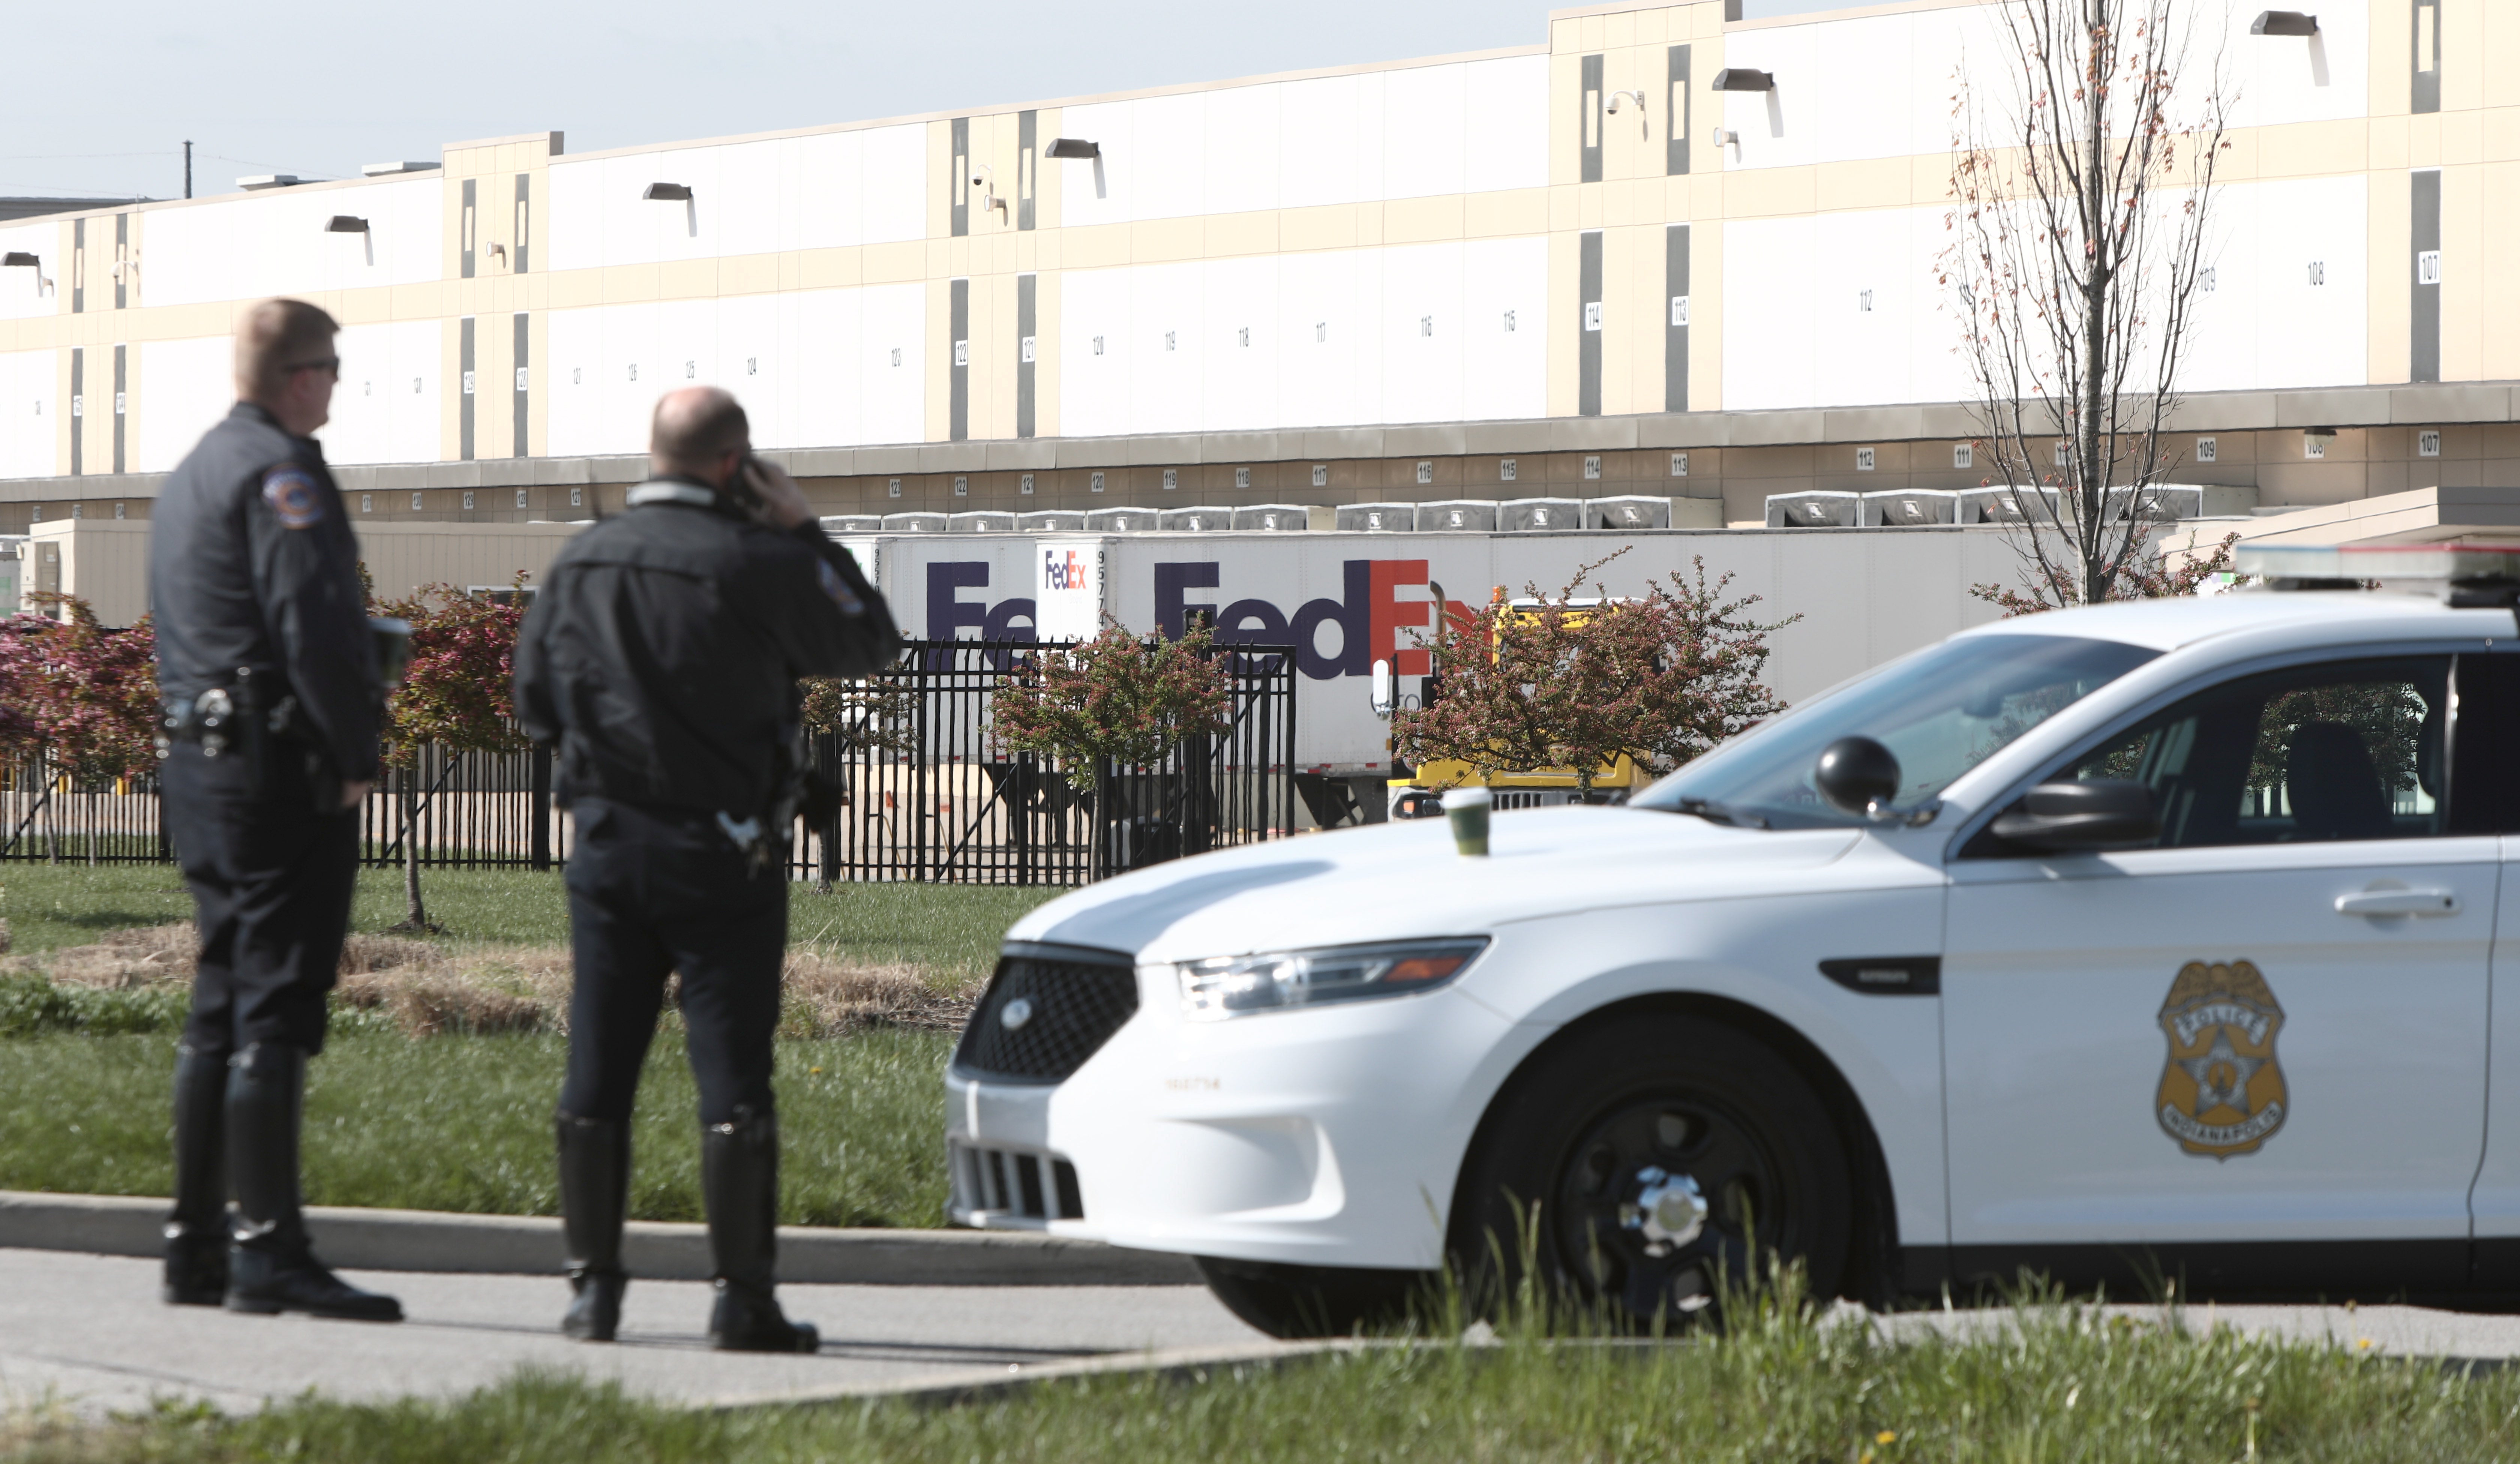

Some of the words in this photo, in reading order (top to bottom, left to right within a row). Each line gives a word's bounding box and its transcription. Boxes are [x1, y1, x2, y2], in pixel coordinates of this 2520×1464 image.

[2308, 261, 2324, 285] 108
[2422, 255, 2438, 280] 107
[2200, 267, 2216, 292] 109
[1860, 289, 1872, 312] 112
[1588, 305, 1599, 327] 114
[1675, 300, 1686, 321] 113
[1421, 315, 1432, 337] 116
[1504, 310, 1515, 332] 115
[1166, 330, 1175, 351] 119
[1239, 327, 1249, 347] 118
[1316, 322, 1326, 343] 117
[957, 344, 966, 363] 122
[1024, 339, 1034, 359] 121
[1094, 336, 1104, 356] 120
[748, 357, 756, 375] 124
[892, 348, 901, 368] 123
[686, 360, 694, 379] 125
[414, 378, 422, 394] 130
[2199, 441, 2215, 458] 109
[2422, 435, 2438, 452] 107
[1674, 458, 1687, 472] 113
[1859, 451, 1872, 466] 112
[1957, 448, 1970, 464] 111
[1314, 468, 1326, 483] 117
[1419, 465, 1431, 479] 116
[1503, 462, 1515, 477] 115
[1586, 460, 1600, 475] 114
[956, 480, 966, 493] 122
[1023, 477, 1034, 490] 121
[1092, 475, 1103, 489] 120
[1165, 472, 1176, 486] 119
[1238, 471, 1250, 485] 118
[572, 491, 581, 504] 127
[891, 482, 900, 495] 123
[465, 494, 473, 506] 129
[1046, 550, 1086, 590] FedEx
[2182, 1007, 2260, 1031] POLICE
